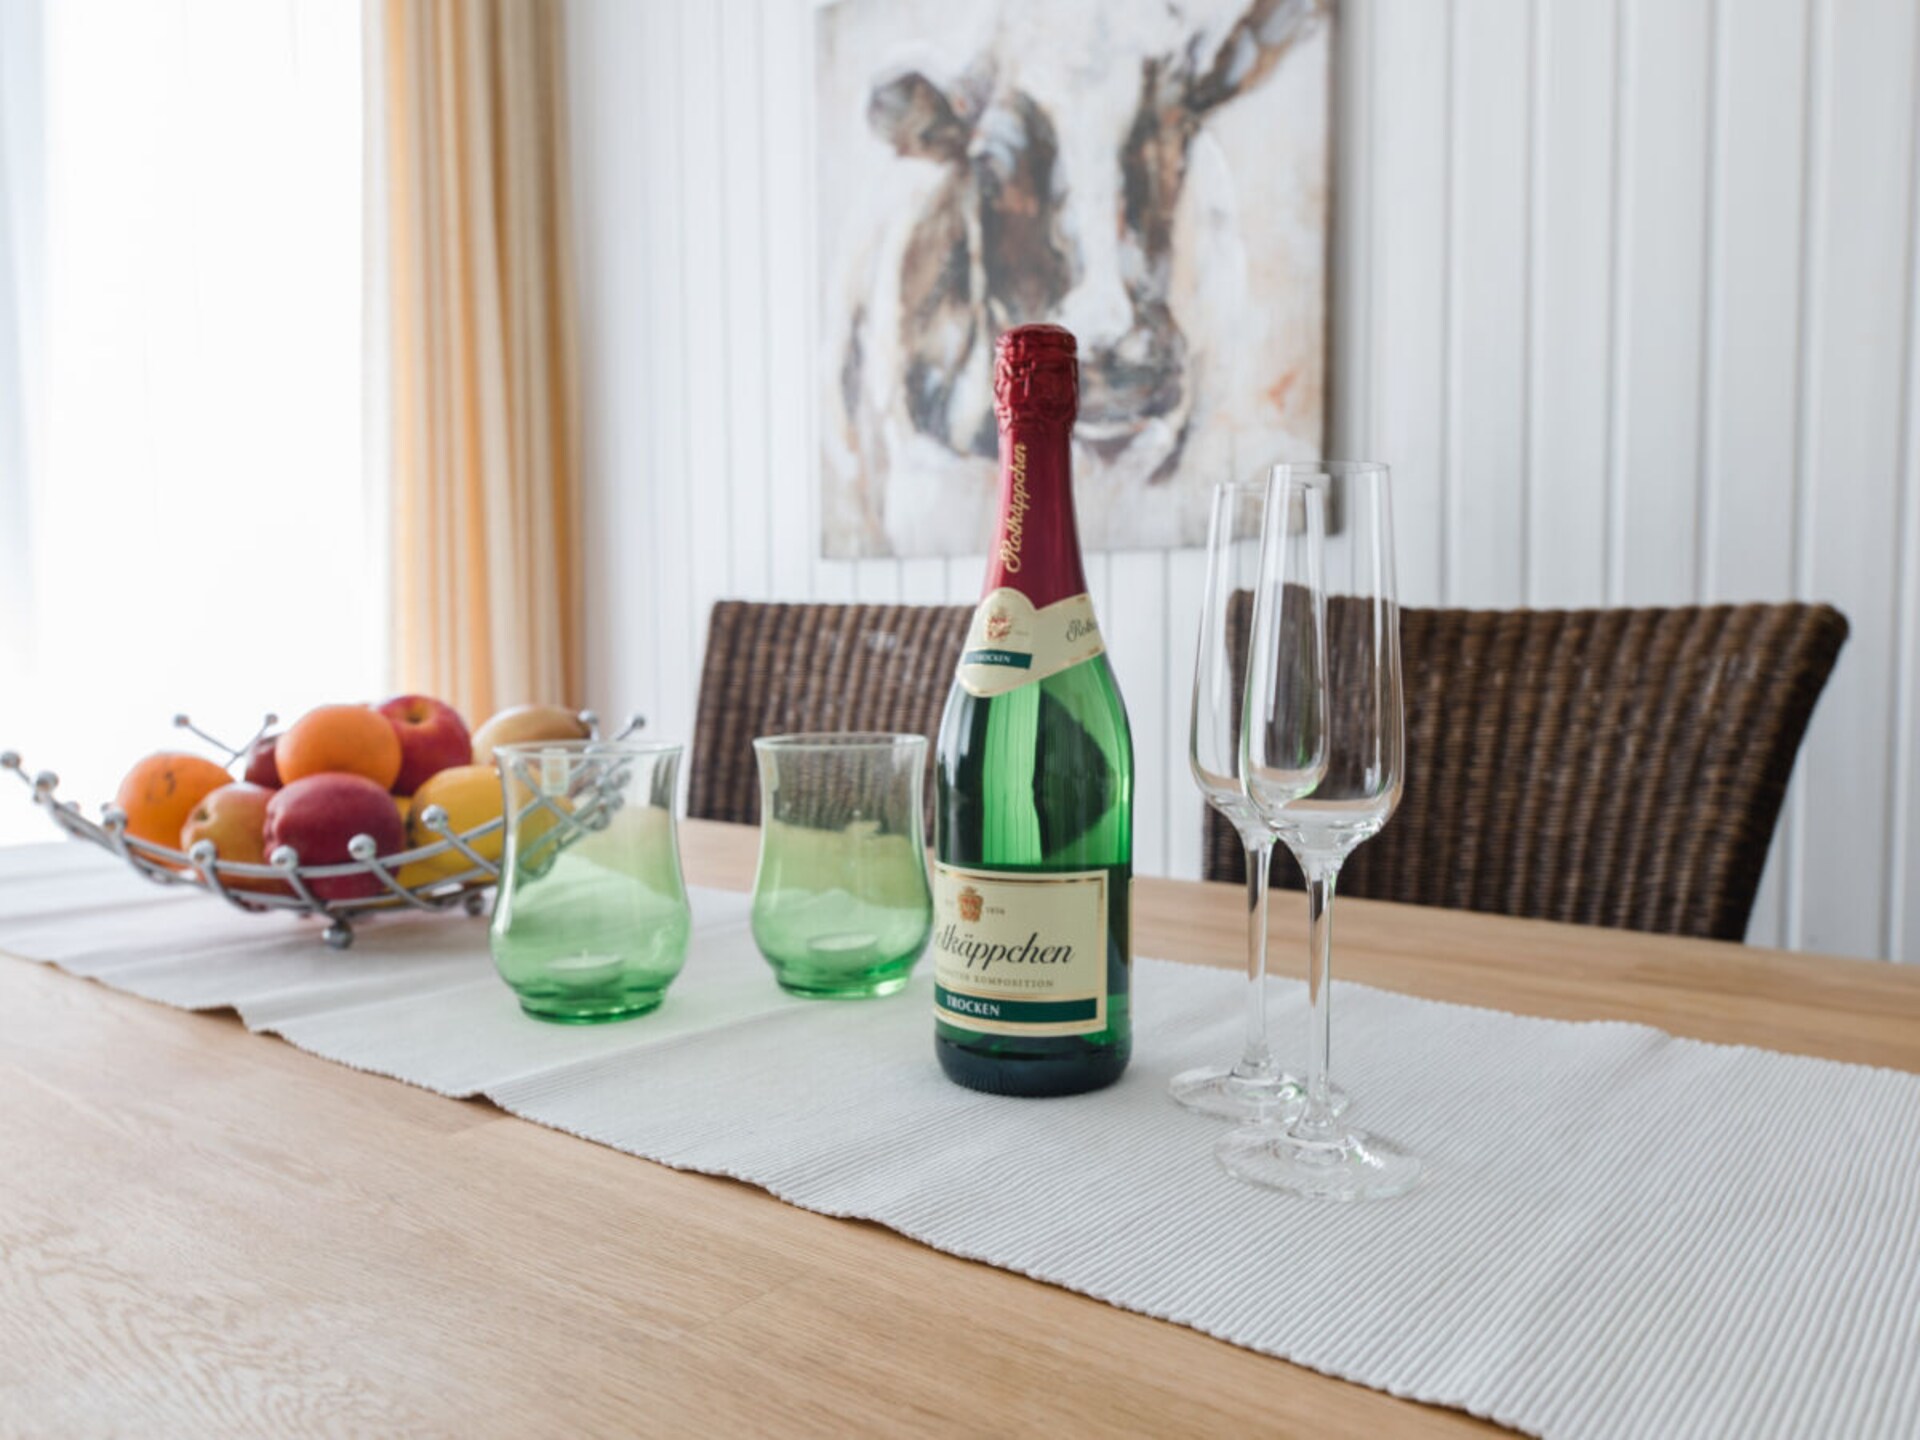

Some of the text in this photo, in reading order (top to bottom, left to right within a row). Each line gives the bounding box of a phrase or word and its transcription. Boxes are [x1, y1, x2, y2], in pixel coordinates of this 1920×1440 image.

[1000, 442, 1031, 573] Rotkäppchen
[974, 974, 1054, 988] KOMPOSITION
[946, 995, 1000, 1017] TROCKEN
